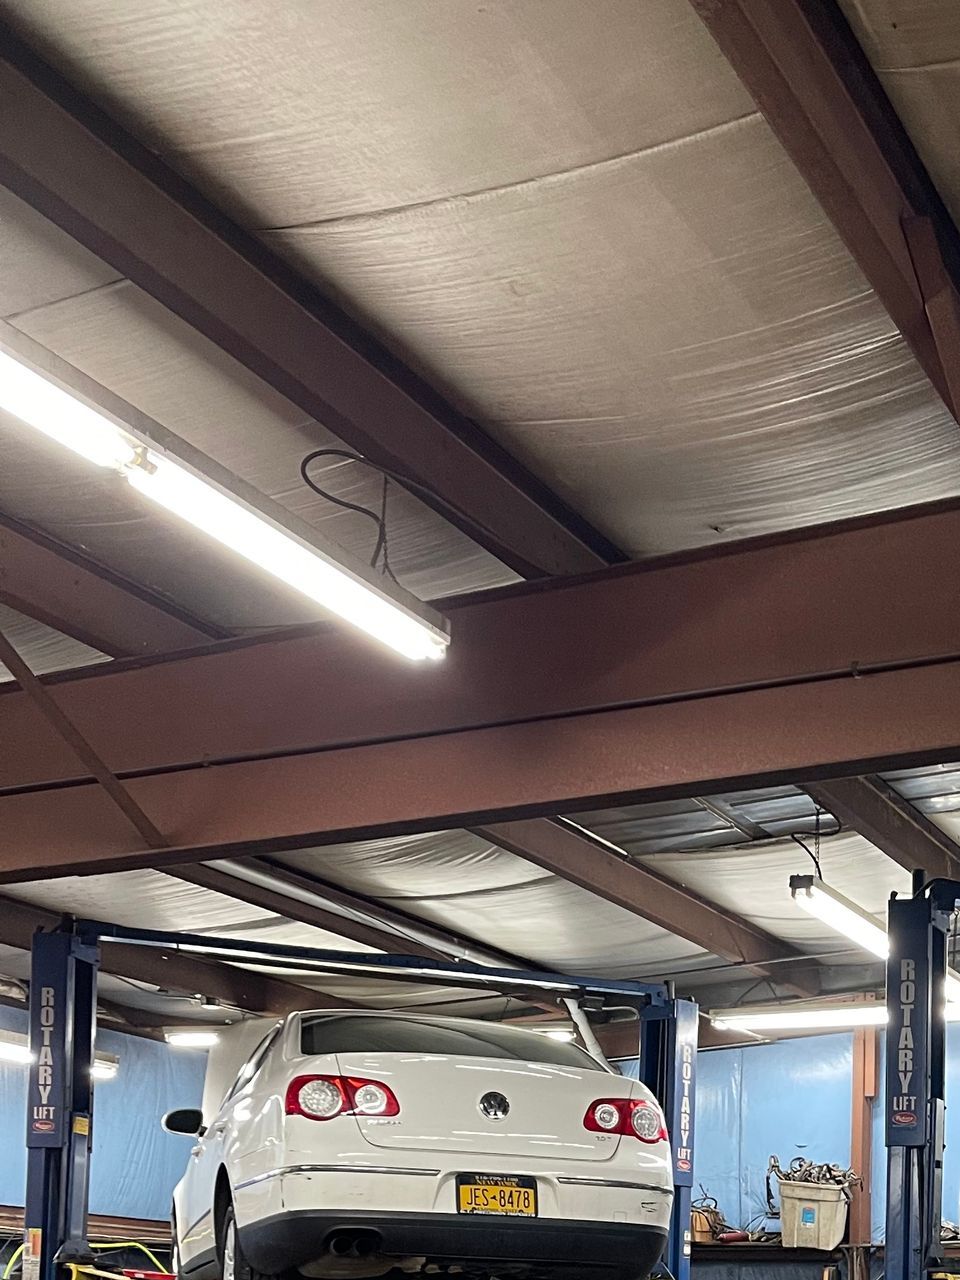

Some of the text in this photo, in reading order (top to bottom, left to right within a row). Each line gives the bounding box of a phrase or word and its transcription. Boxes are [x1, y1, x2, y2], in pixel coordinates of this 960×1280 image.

[38, 987, 55, 1104] ROTARY
[898, 959, 915, 1094] ROTARY
[33, 1106, 55, 1120] LIFT
[681, 1044, 691, 1147] ROTARY
[893, 1096, 917, 1111] LIFT
[677, 1147, 691, 1160] LIFT
